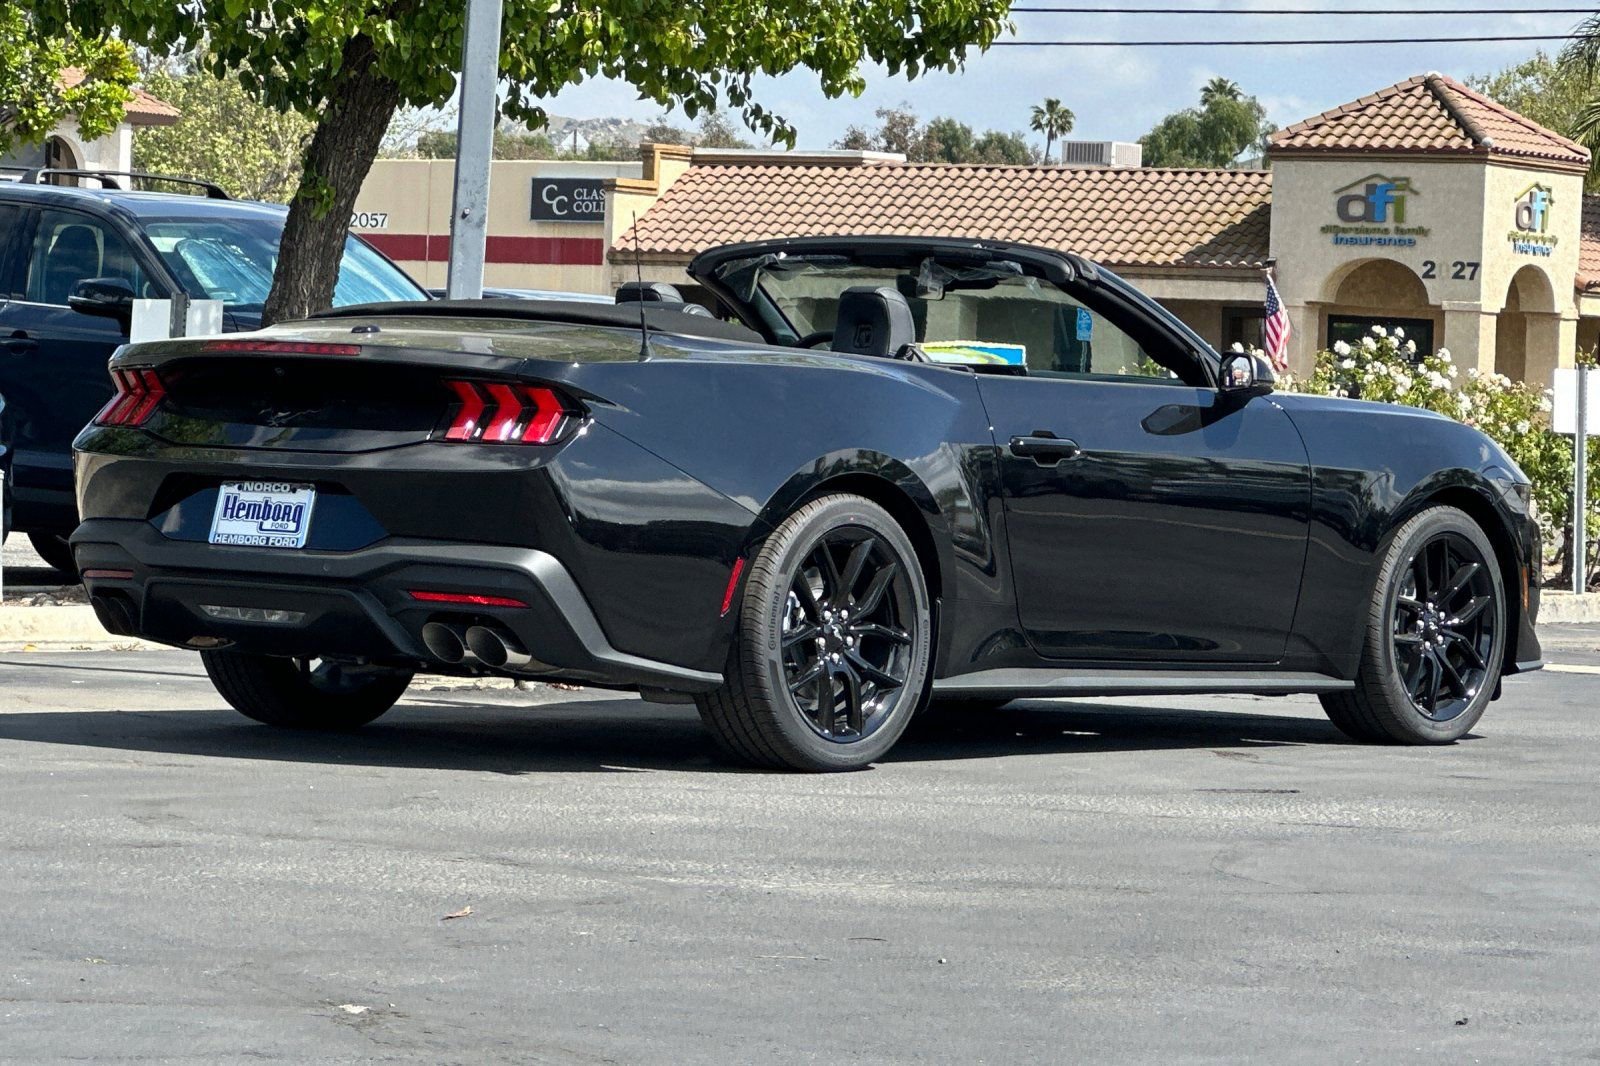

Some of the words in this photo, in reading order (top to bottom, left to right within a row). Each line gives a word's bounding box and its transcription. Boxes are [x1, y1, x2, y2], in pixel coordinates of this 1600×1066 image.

[573, 201, 606, 213] COLL
[1337, 183, 1405, 223] dfi
[350, 212, 388, 228] 2057
[1334, 234, 1416, 246] insurance
[243, 482, 291, 493] NORCO
[214, 534, 267, 545] HEMBORG
[269, 537, 297, 547] FORD
